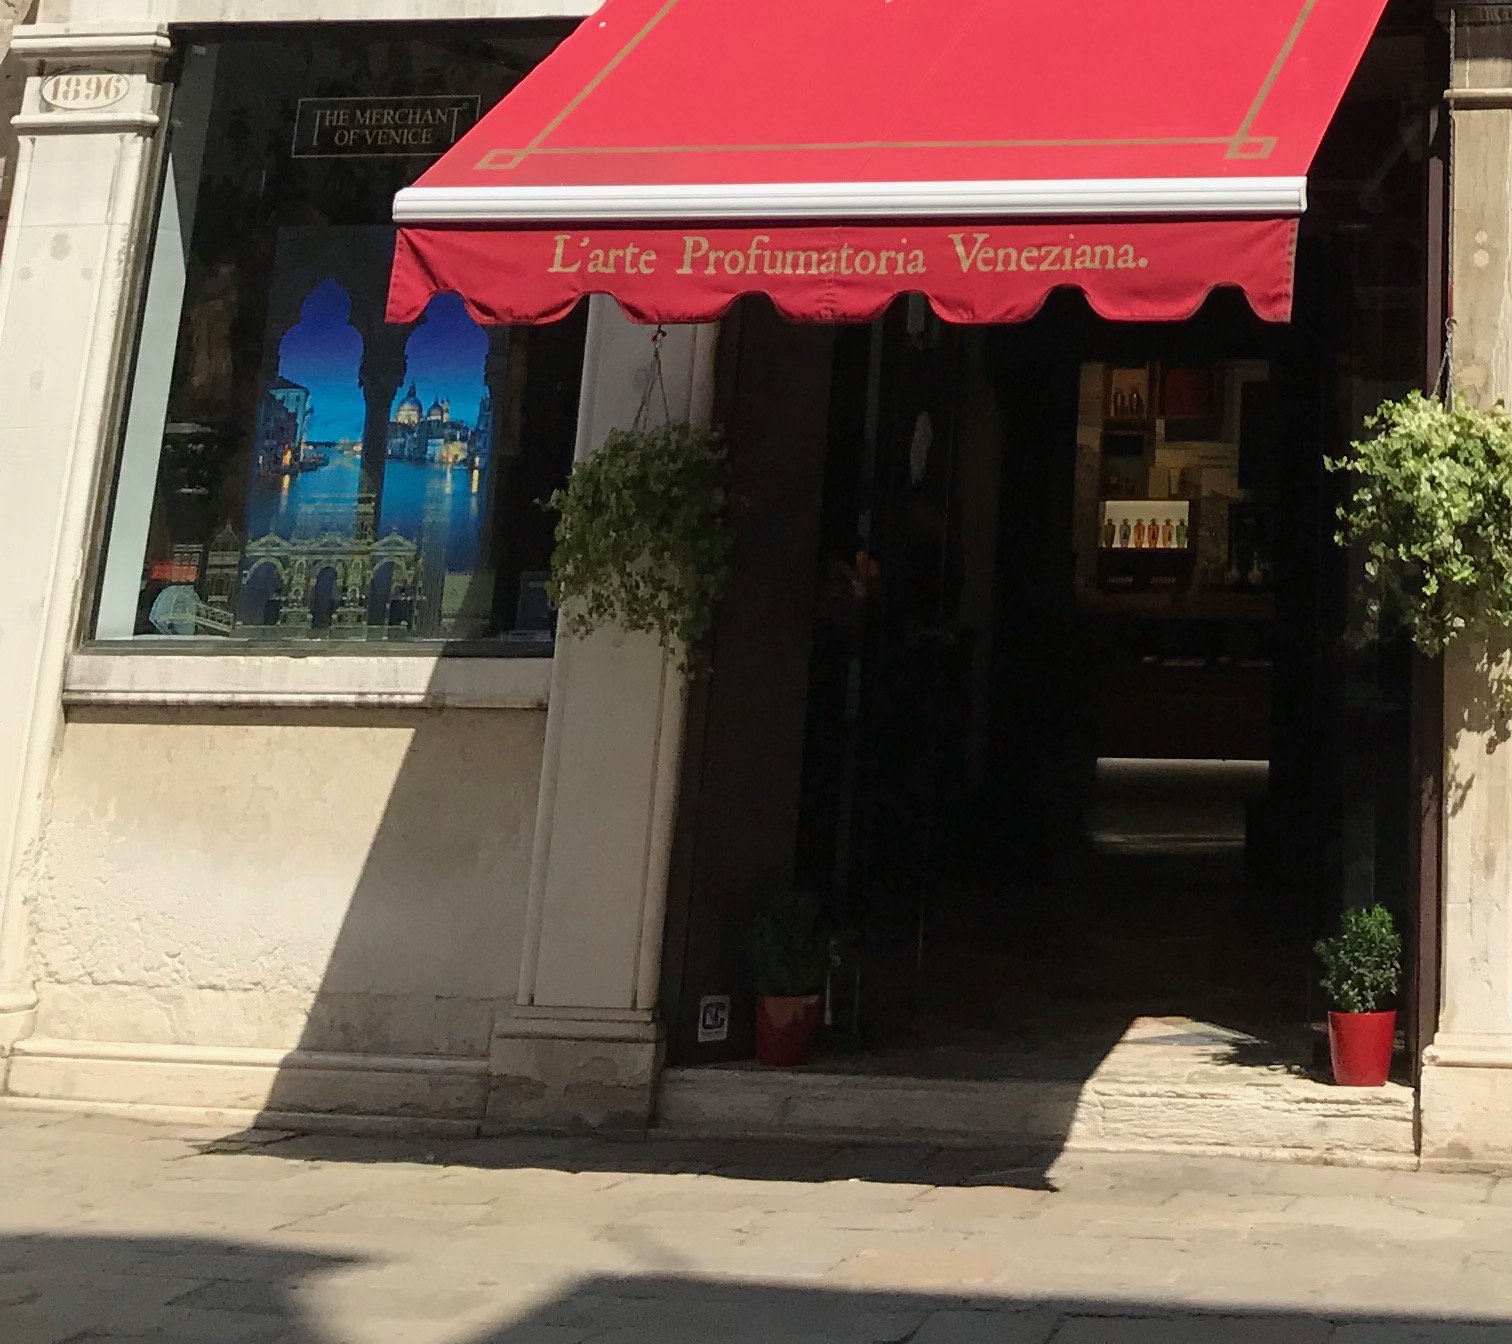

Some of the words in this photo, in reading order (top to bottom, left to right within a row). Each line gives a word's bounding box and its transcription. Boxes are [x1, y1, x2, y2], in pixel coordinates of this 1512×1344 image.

[51, 75, 121, 101] 1896
[313, 109, 351, 145] THE
[355, 107, 462, 143] MERCHANT
[334, 129, 359, 145] OF
[363, 127, 433, 145] VENICE
[547, 234, 657, 274] L'arte
[675, 234, 926, 275] Profumatoria
[950, 233, 1149, 274] Veneziana.
